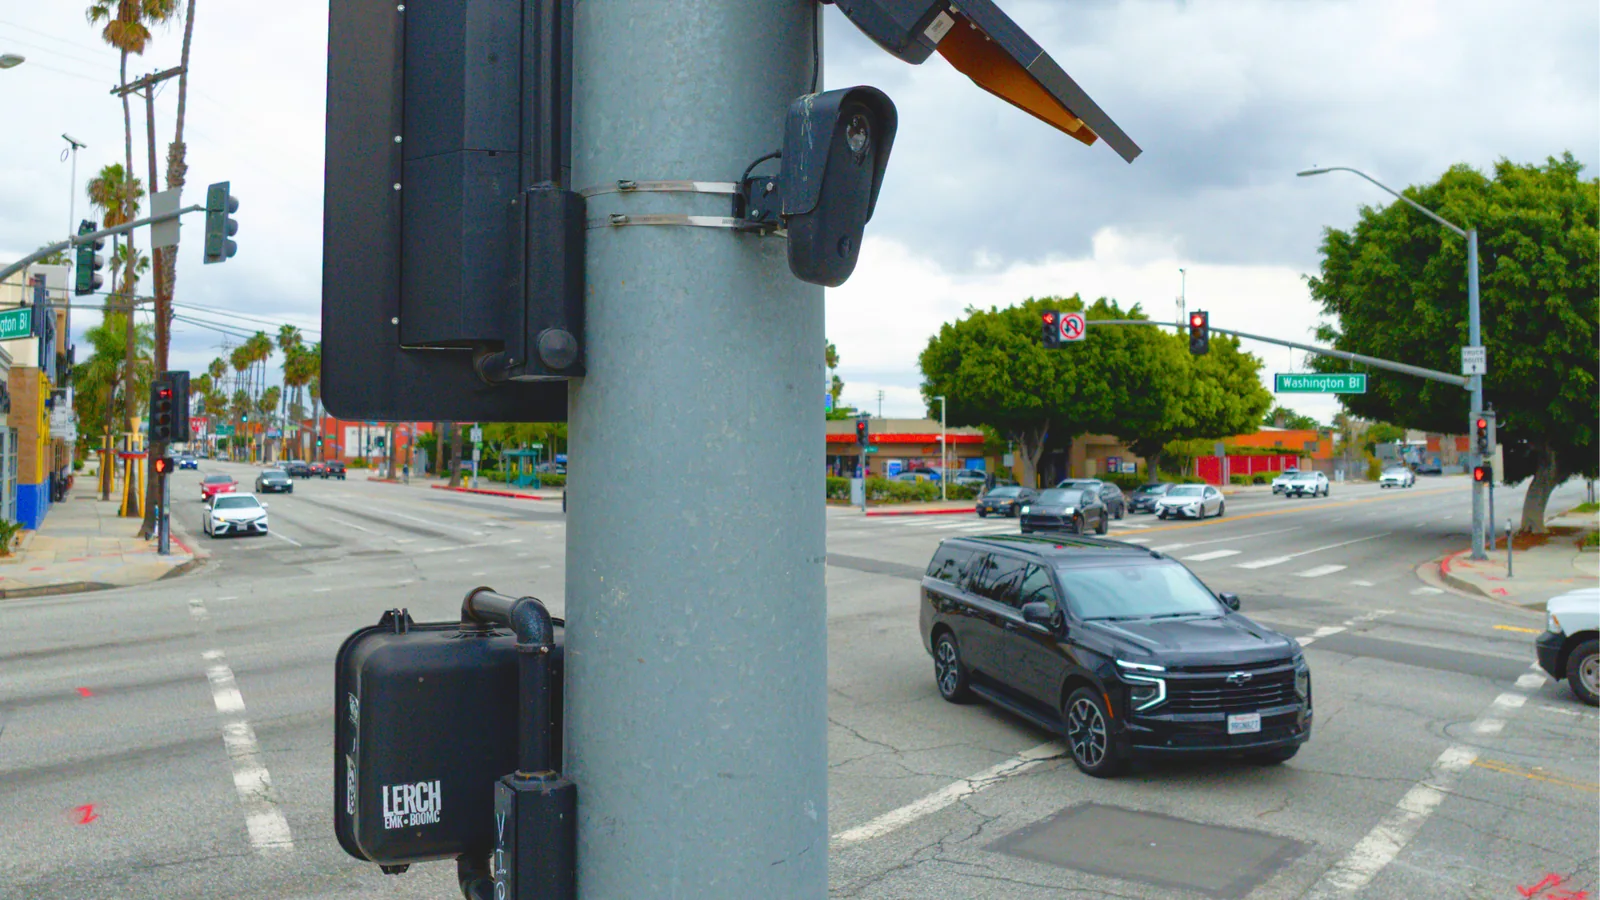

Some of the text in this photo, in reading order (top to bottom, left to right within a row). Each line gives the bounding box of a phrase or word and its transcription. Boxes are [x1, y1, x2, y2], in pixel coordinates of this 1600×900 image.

[0, 316, 17, 338] gton
[1283, 377, 1360, 392] Washington Bl
[383, 780, 441, 817] LERCH
